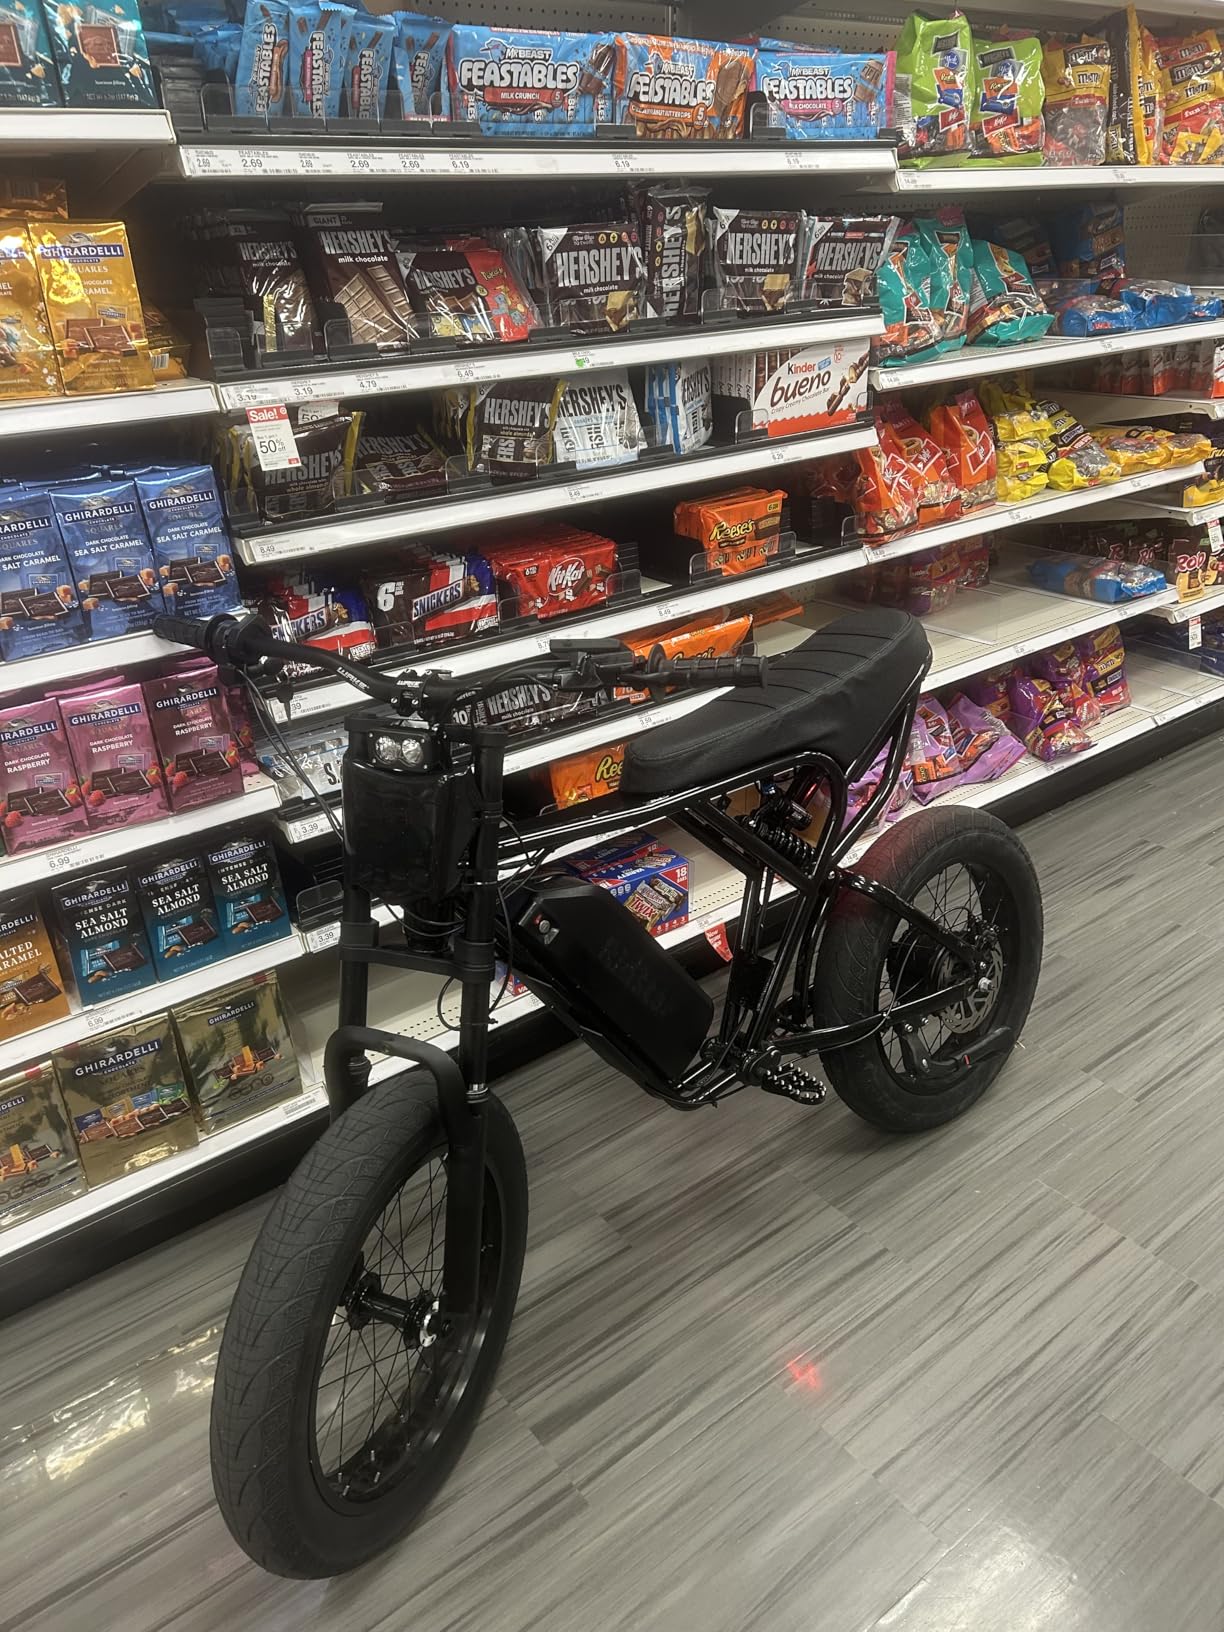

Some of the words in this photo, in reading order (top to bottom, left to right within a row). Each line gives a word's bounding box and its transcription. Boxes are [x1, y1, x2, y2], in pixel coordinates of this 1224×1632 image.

[461, 61, 578, 89] FEASTABLES
[500, 92, 514, 100] MILK
[515, 92, 540, 101] CRUNCH
[697, 108, 705, 119] 5
[242, 159, 263, 168] 2.69
[350, 160, 369, 168] 2.69
[401, 160, 420, 169] 2.69
[452, 160, 470, 169] 6.19
[240, 241, 297, 261] HERSHEY'S
[319, 230, 398, 254] HERSHEY'S
[726, 233, 796, 265] HERSHEY'S
[43, 246, 122, 258] GHIRARDELLI
[339, 256, 354, 264] milk
[355, 255, 388, 263] chocolate
[819, 242, 882, 272] HERSHEY'S
[556, 247, 647, 287] HERSHEY'S
[662, 206, 684, 318] HERSHEY'S
[413, 267, 476, 290] HERSHEY'S
[583, 286, 595, 294] milk
[595, 284, 618, 292] chocolate
[457, 370, 474, 378] 6.49
[787, 362, 816, 375] kinder
[294, 387, 313, 396] 3.19
[360, 380, 377, 389] 4.79
[771, 370, 831, 408] bueno
[558, 383, 628, 418] HERSHEY'S
[249, 407, 279, 421] Sale!
[484, 397, 551, 429] HERSHEY'S
[149, 492, 213, 510] GHIRARDELLI
[65, 505, 134, 523] GHIRARDELLI
[157, 534, 172, 543] SEA
[172, 531, 188, 541] SALT
[189, 526, 222, 538] CARAMEL
[167, 526, 181, 534] DARK
[182, 521, 209, 531] CHOCOLATE
[709, 519, 755, 541] Reese's
[74, 548, 90, 557] SEA
[90, 544, 108, 555] SALT
[109, 539, 144, 552] CARAMEL
[85, 538, 99, 547] DARK
[101, 534, 129, 544] CHOCOLATE
[260, 545, 275, 554] 8.49
[2, 561, 21, 571] SALT
[23, 554, 61, 567] CARAMEL
[376, 581, 396, 612] 6
[413, 582, 461, 618] SNICKERS
[156, 688, 218, 709] GHIRARDELLI
[486, 684, 551, 716] HERSHEY'S
[71, 704, 140, 725] GHIRARDELLI
[453, 709, 469, 725] 10
[512, 707, 535, 718] chocolate
[175, 722, 213, 736] RASPBERRY
[89, 740, 104, 748] DARK
[104, 733, 133, 745] CHOCOLATE
[92, 739, 134, 754] RASPBERRY
[4, 758, 19, 767] DARK
[20, 752, 50, 763] CHOCOLATE
[7, 758, 51, 774] RASPBERRY
[301, 823, 319, 834] 3.39
[211, 840, 266, 863] GHIRARDELLI
[49, 856, 70, 869] 6.99
[676, 866, 688, 877] 18
[142, 860, 198, 884] GHIRARDELLI
[221, 874, 242, 885] SEA
[244, 863, 269, 877] SALT
[226, 872, 270, 893] ALMOND
[64, 884, 127, 907] GHIRARDELLI
[151, 896, 171, 908] SEA
[174, 884, 200, 897] SALT
[157, 894, 200, 915] ALMOND
[630, 895, 658, 919] TWIX
[75, 917, 97, 931] SEA
[100, 907, 129, 923] SALT
[80, 917, 129, 939] ALMOND
[318, 931, 334, 943] 3.39
[208, 1001, 255, 1025] GHIRARDELLI
[75, 1040, 159, 1077] GHIRARDELLI
